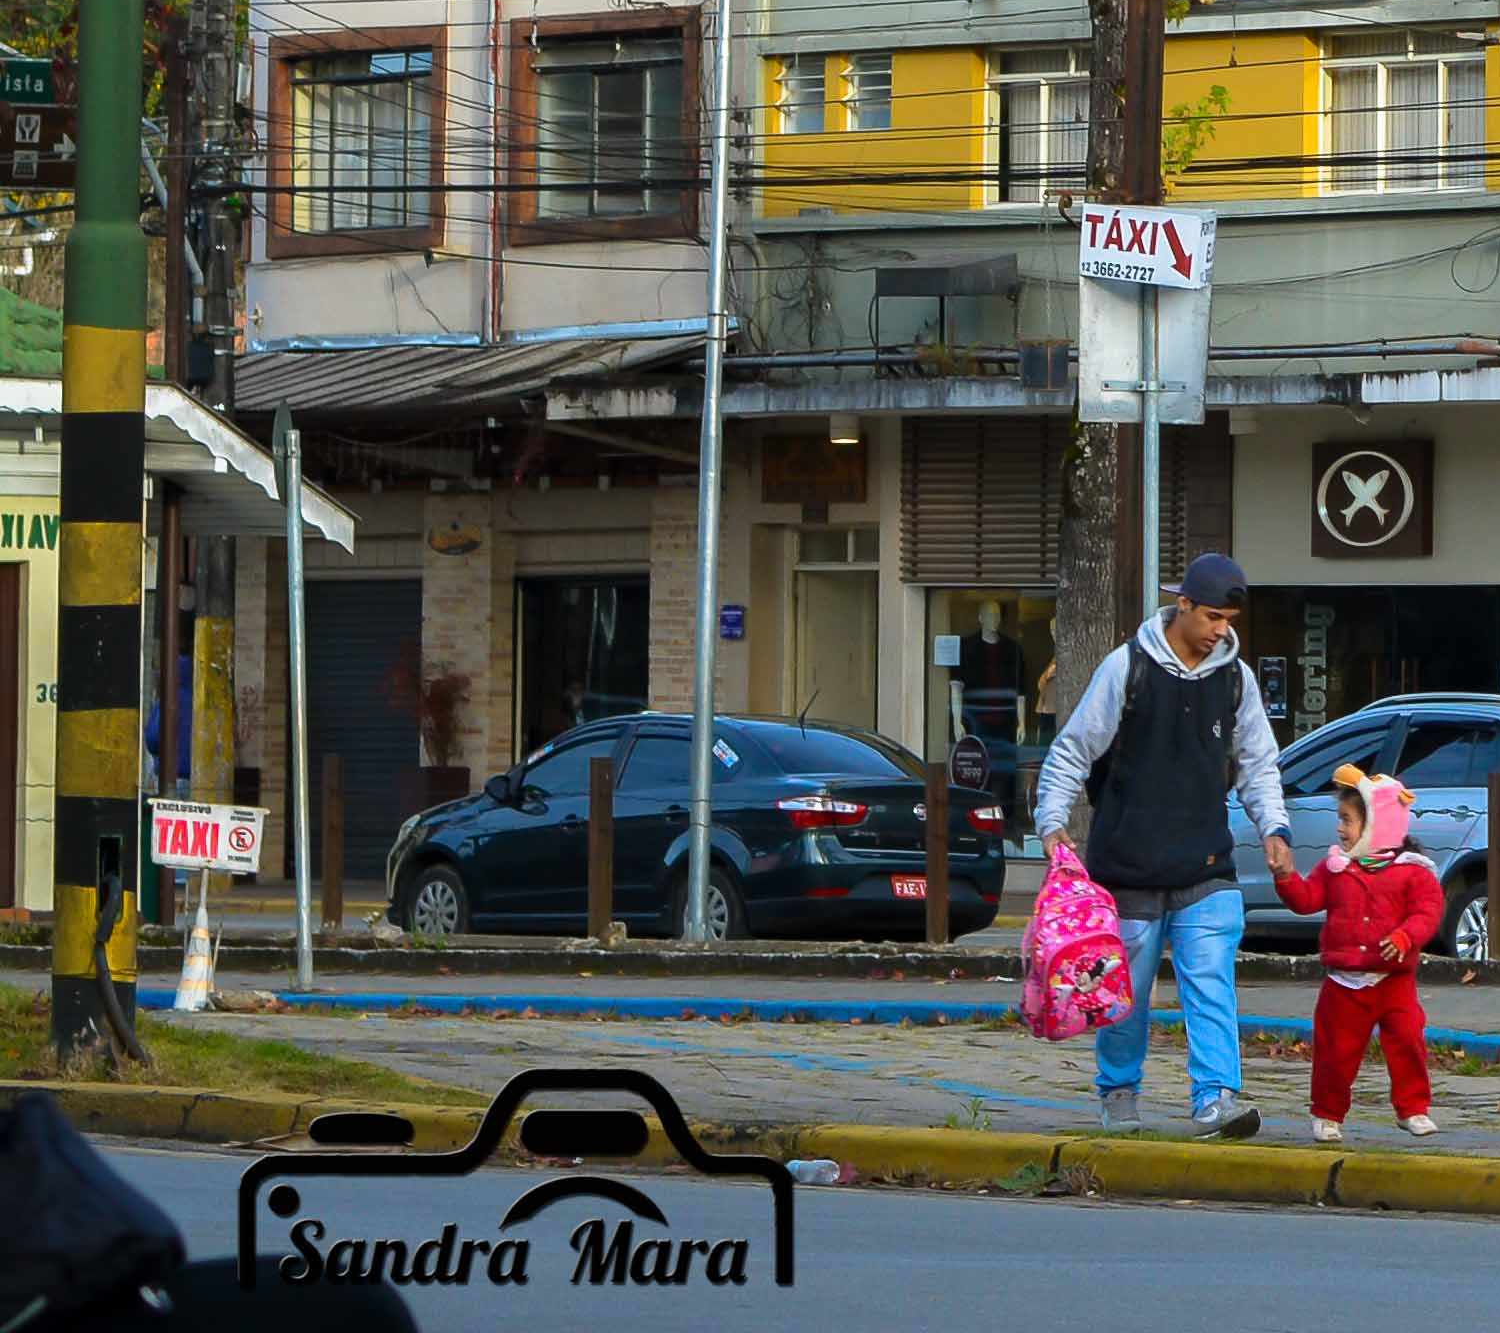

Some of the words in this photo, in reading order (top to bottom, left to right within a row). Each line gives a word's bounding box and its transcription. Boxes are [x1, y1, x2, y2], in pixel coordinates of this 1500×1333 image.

[4, 74, 44, 93] ista
[1085, 209, 1159, 255] TÁXI
[1092, 260, 1155, 282] 3662-2727
[155, 817, 220, 860] TAXI
